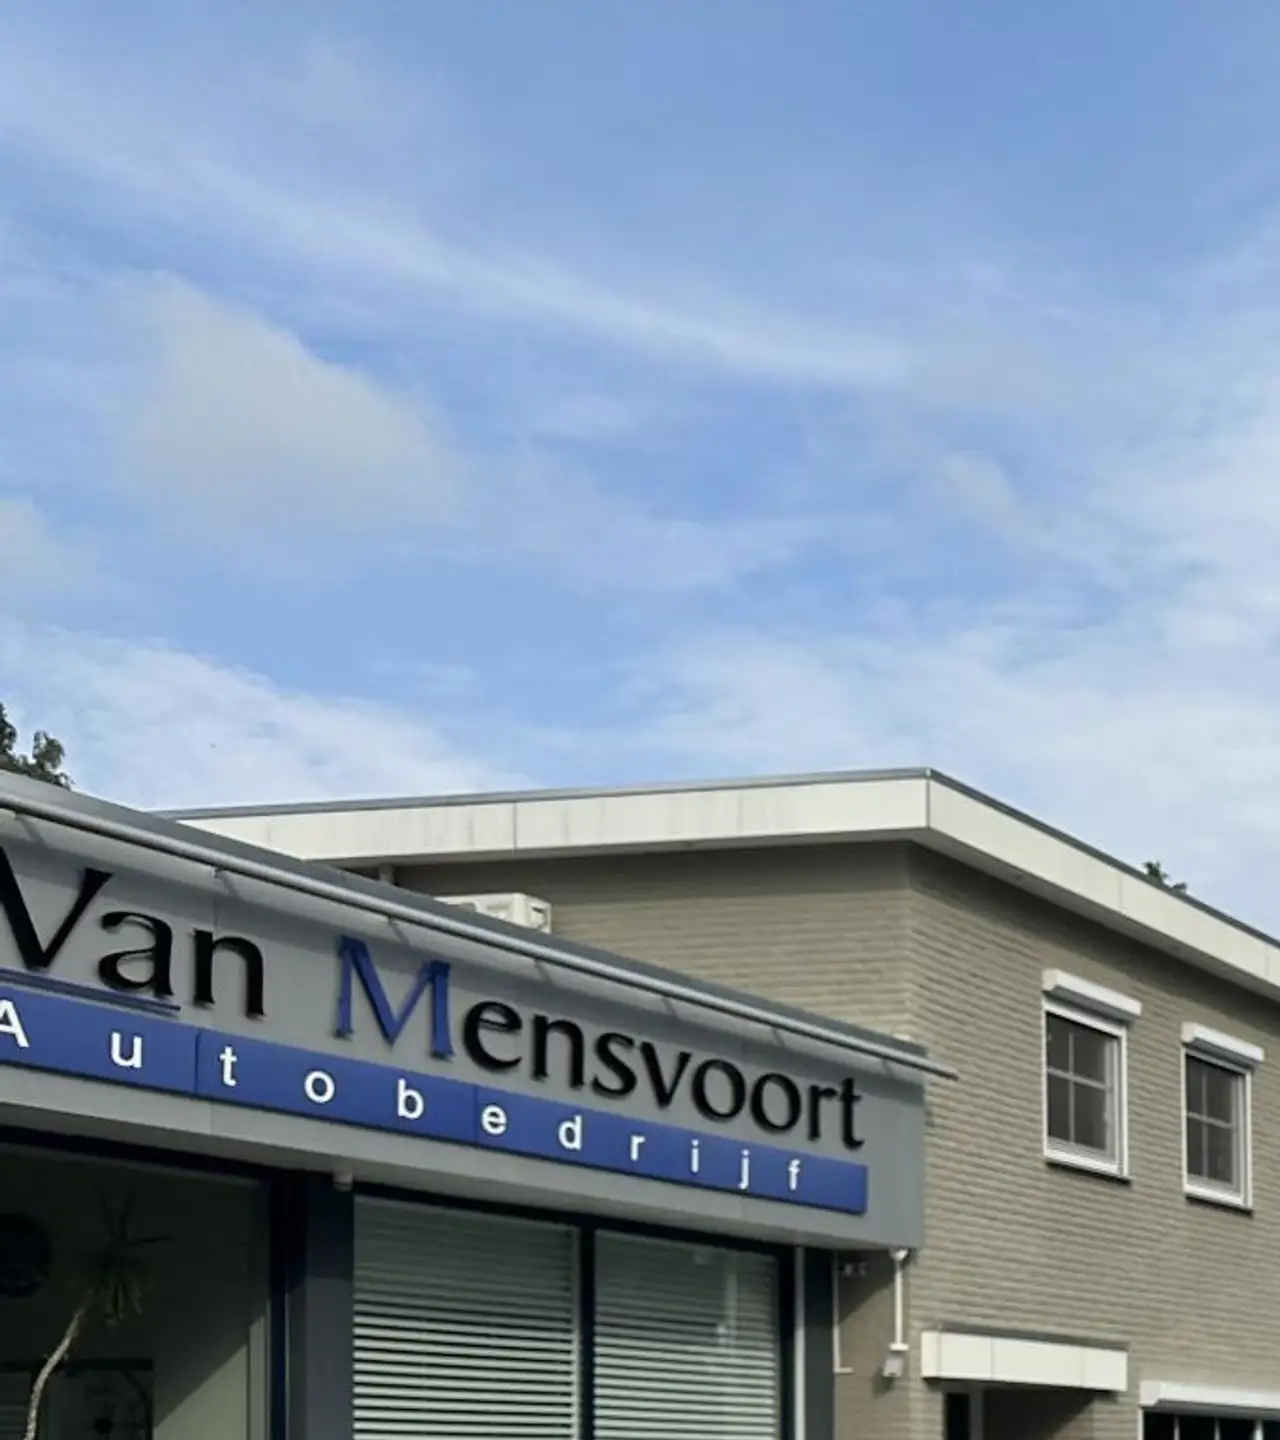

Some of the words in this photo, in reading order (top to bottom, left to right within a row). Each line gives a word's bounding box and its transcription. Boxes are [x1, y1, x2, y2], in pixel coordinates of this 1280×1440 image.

[0, 846, 265, 1020] Van
[334, 934, 867, 1150] Mensvoort
[0, 999, 804, 1191] Autobedrijf
